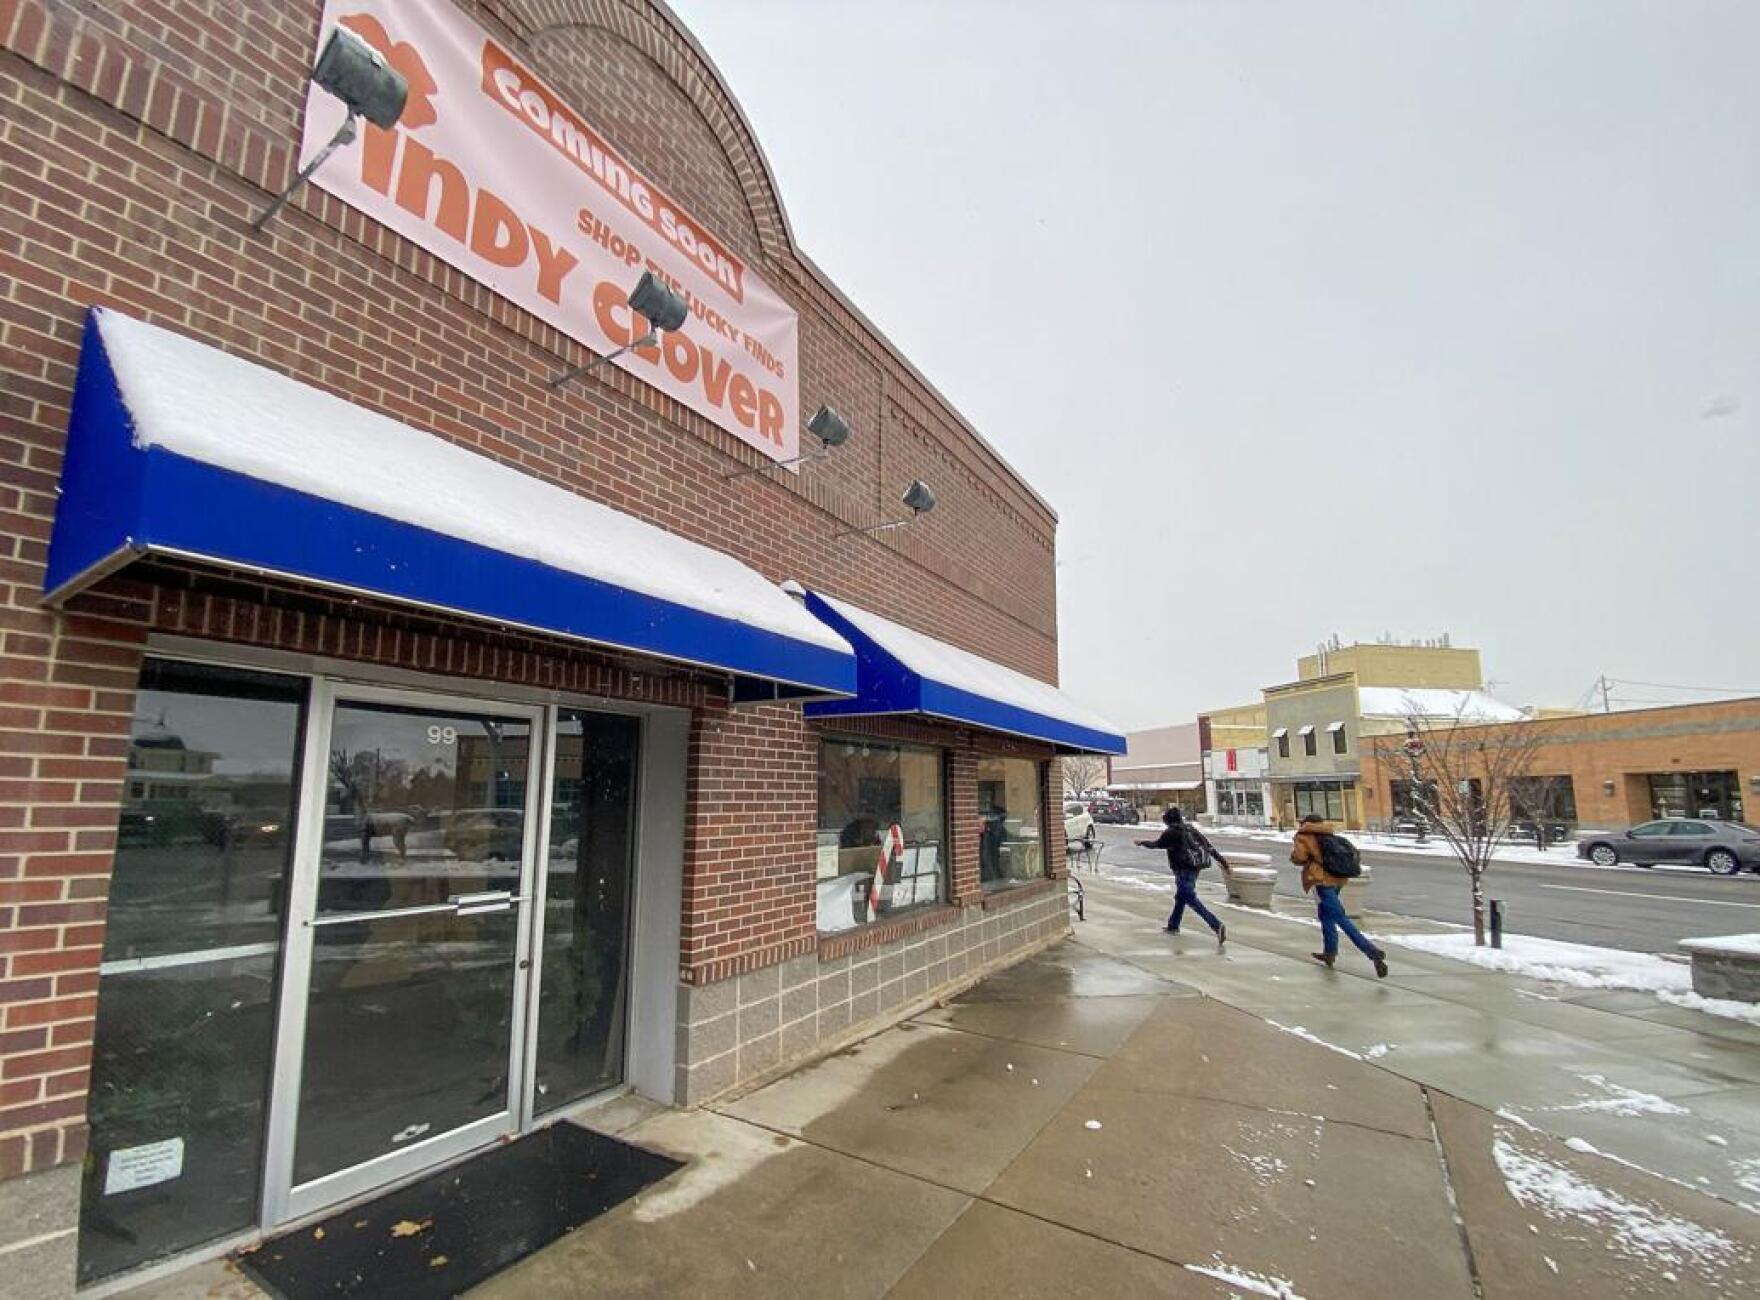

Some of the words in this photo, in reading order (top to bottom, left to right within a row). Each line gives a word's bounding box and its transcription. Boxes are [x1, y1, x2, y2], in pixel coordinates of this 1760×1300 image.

[577, 208, 641, 268] SHOP
[685, 290, 739, 344] LUCKY
[744, 332, 785, 379] FINDS
[427, 724, 456, 745] 99
